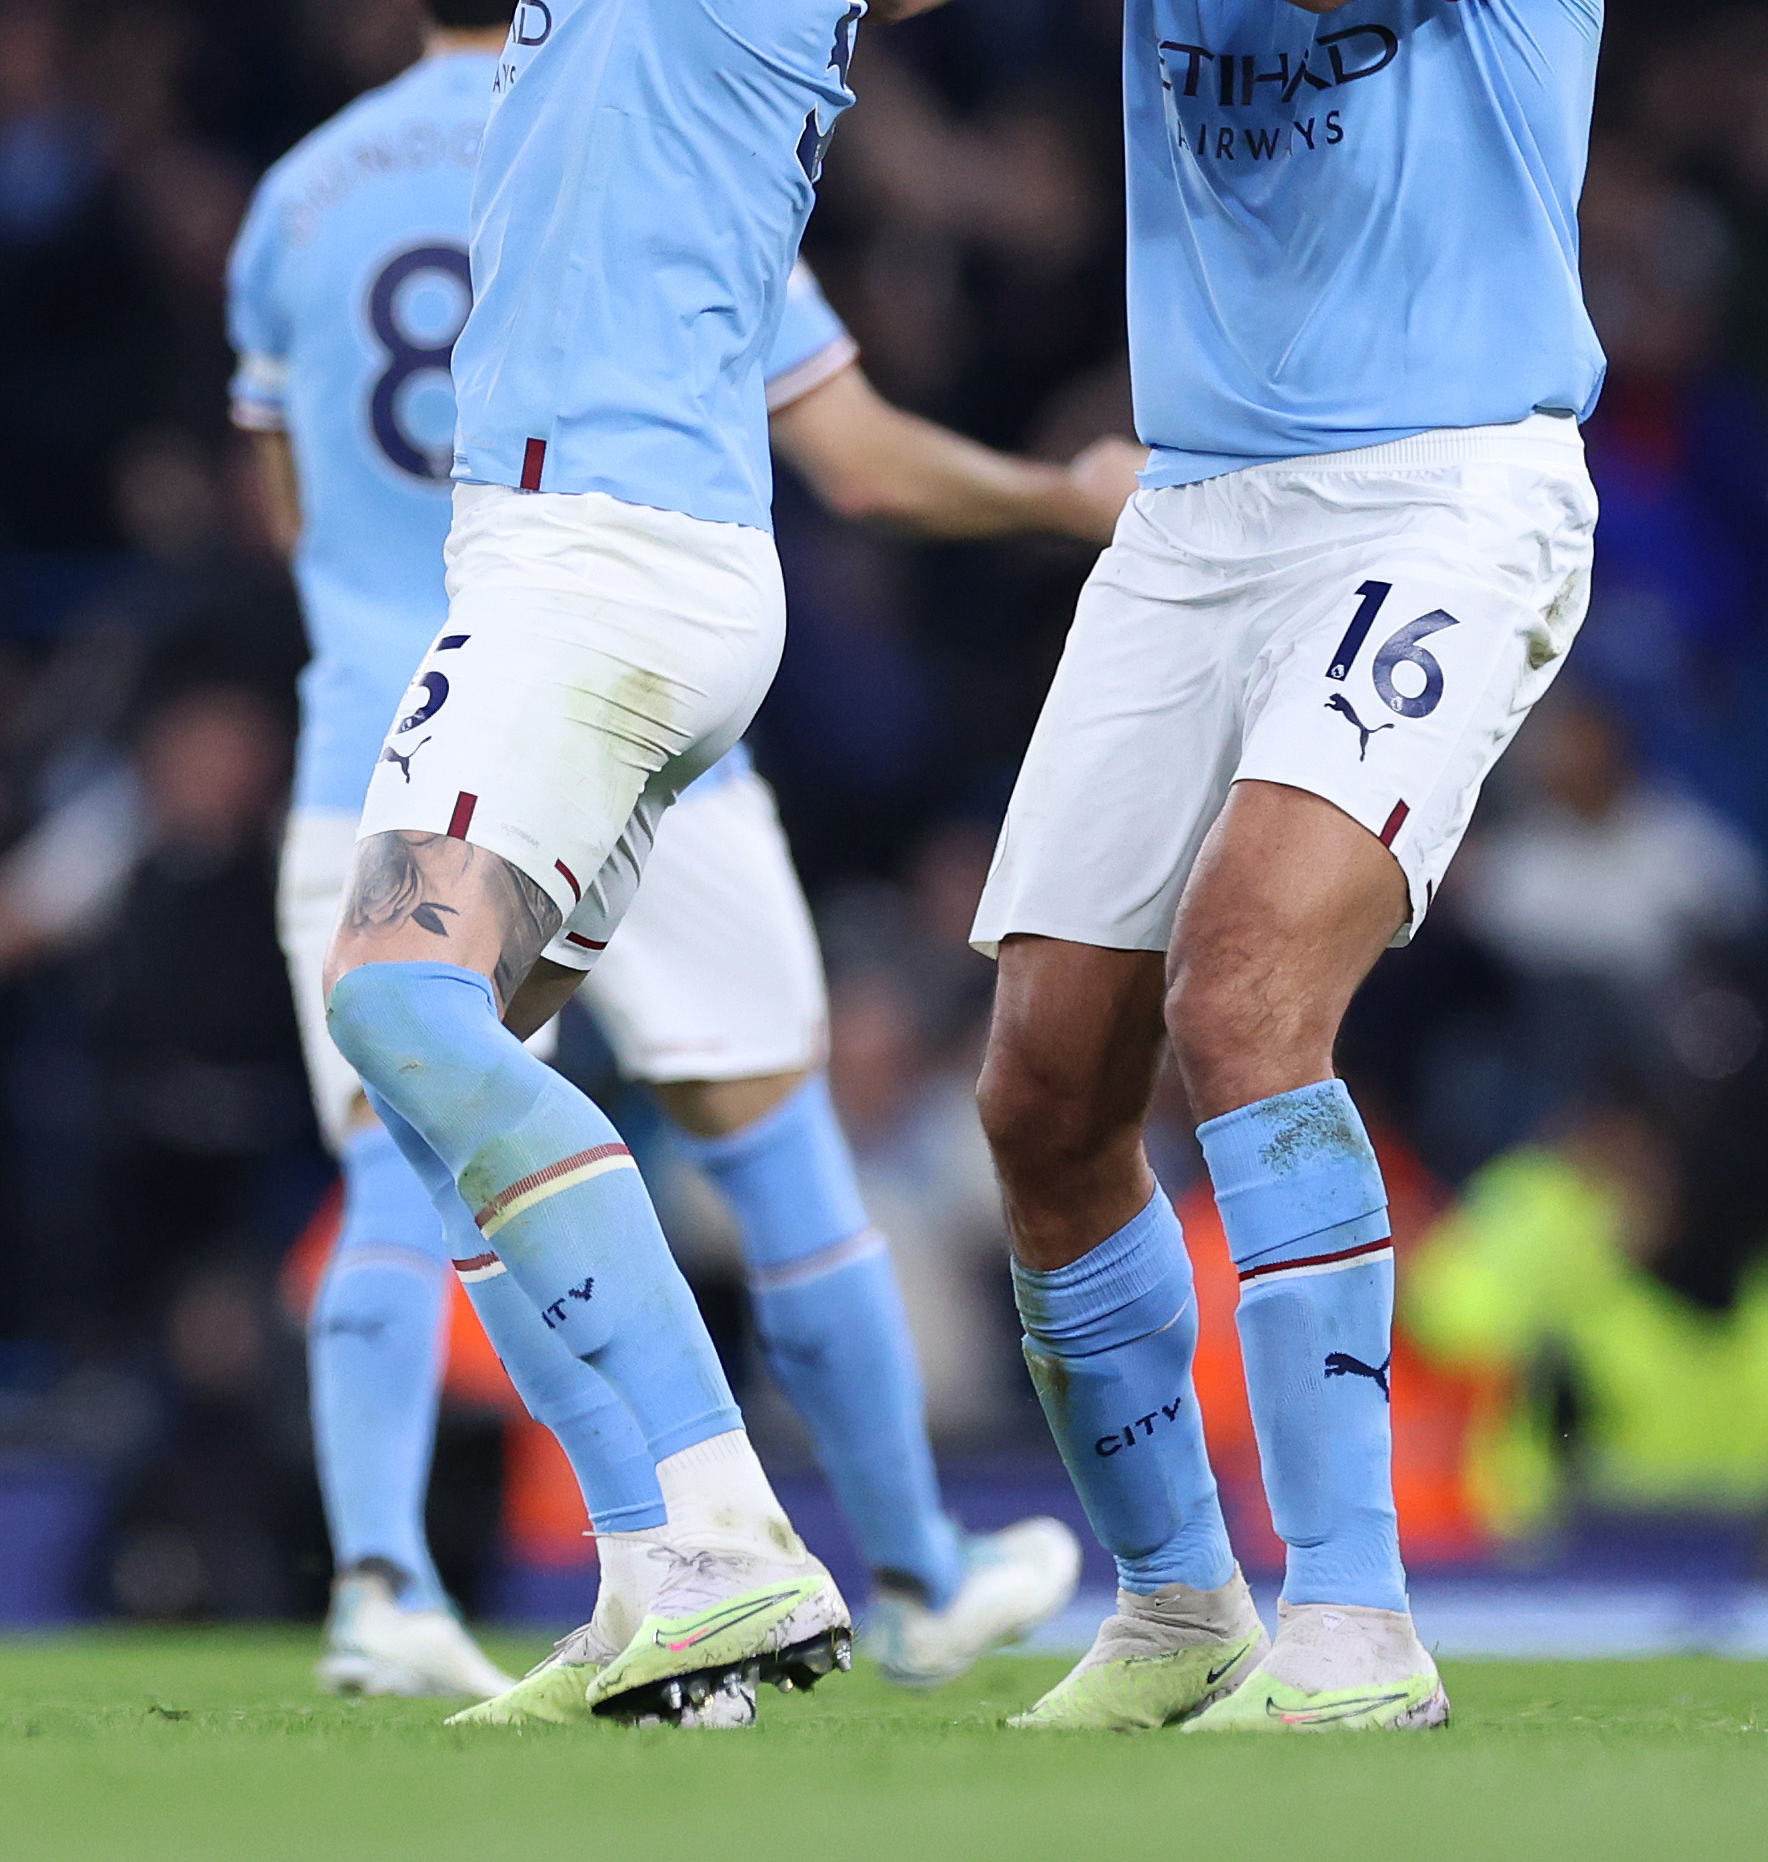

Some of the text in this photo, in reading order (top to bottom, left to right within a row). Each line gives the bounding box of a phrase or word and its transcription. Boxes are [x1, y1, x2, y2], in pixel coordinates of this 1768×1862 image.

[1158, 23, 1399, 104] TIHAD
[366, 242, 473, 482] 8
[1324, 579, 1461, 718] 16
[541, 1277, 594, 1329] ITY
[1096, 1397, 1181, 1457] CITY
